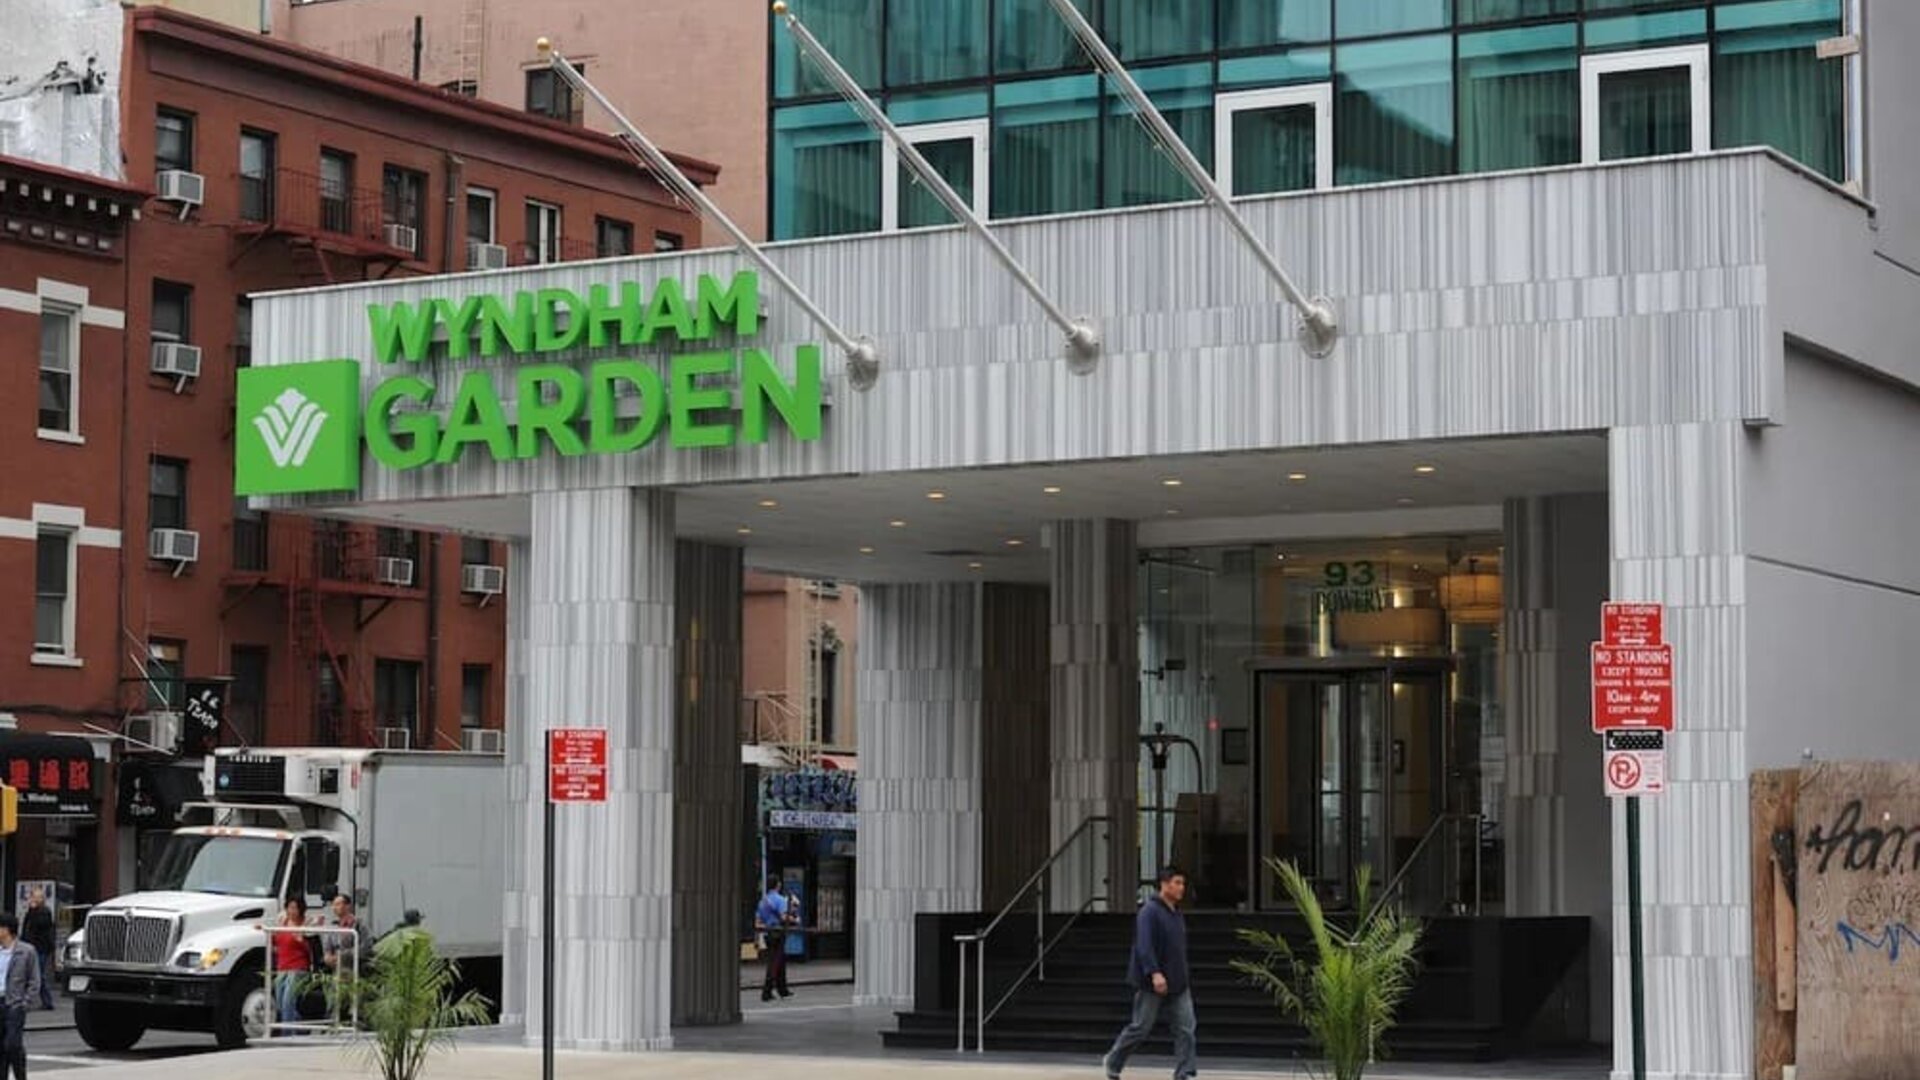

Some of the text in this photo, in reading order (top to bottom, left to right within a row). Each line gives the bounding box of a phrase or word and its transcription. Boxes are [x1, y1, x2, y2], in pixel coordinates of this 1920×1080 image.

[367, 270, 760, 364] WYNDHAM
[364, 344, 822, 470] GARDEN
[1325, 561, 1375, 587] 93
[1595, 651, 1669, 665] NO STANDING
[1602, 667, 1664, 677] EXCEPT TRUCKS
